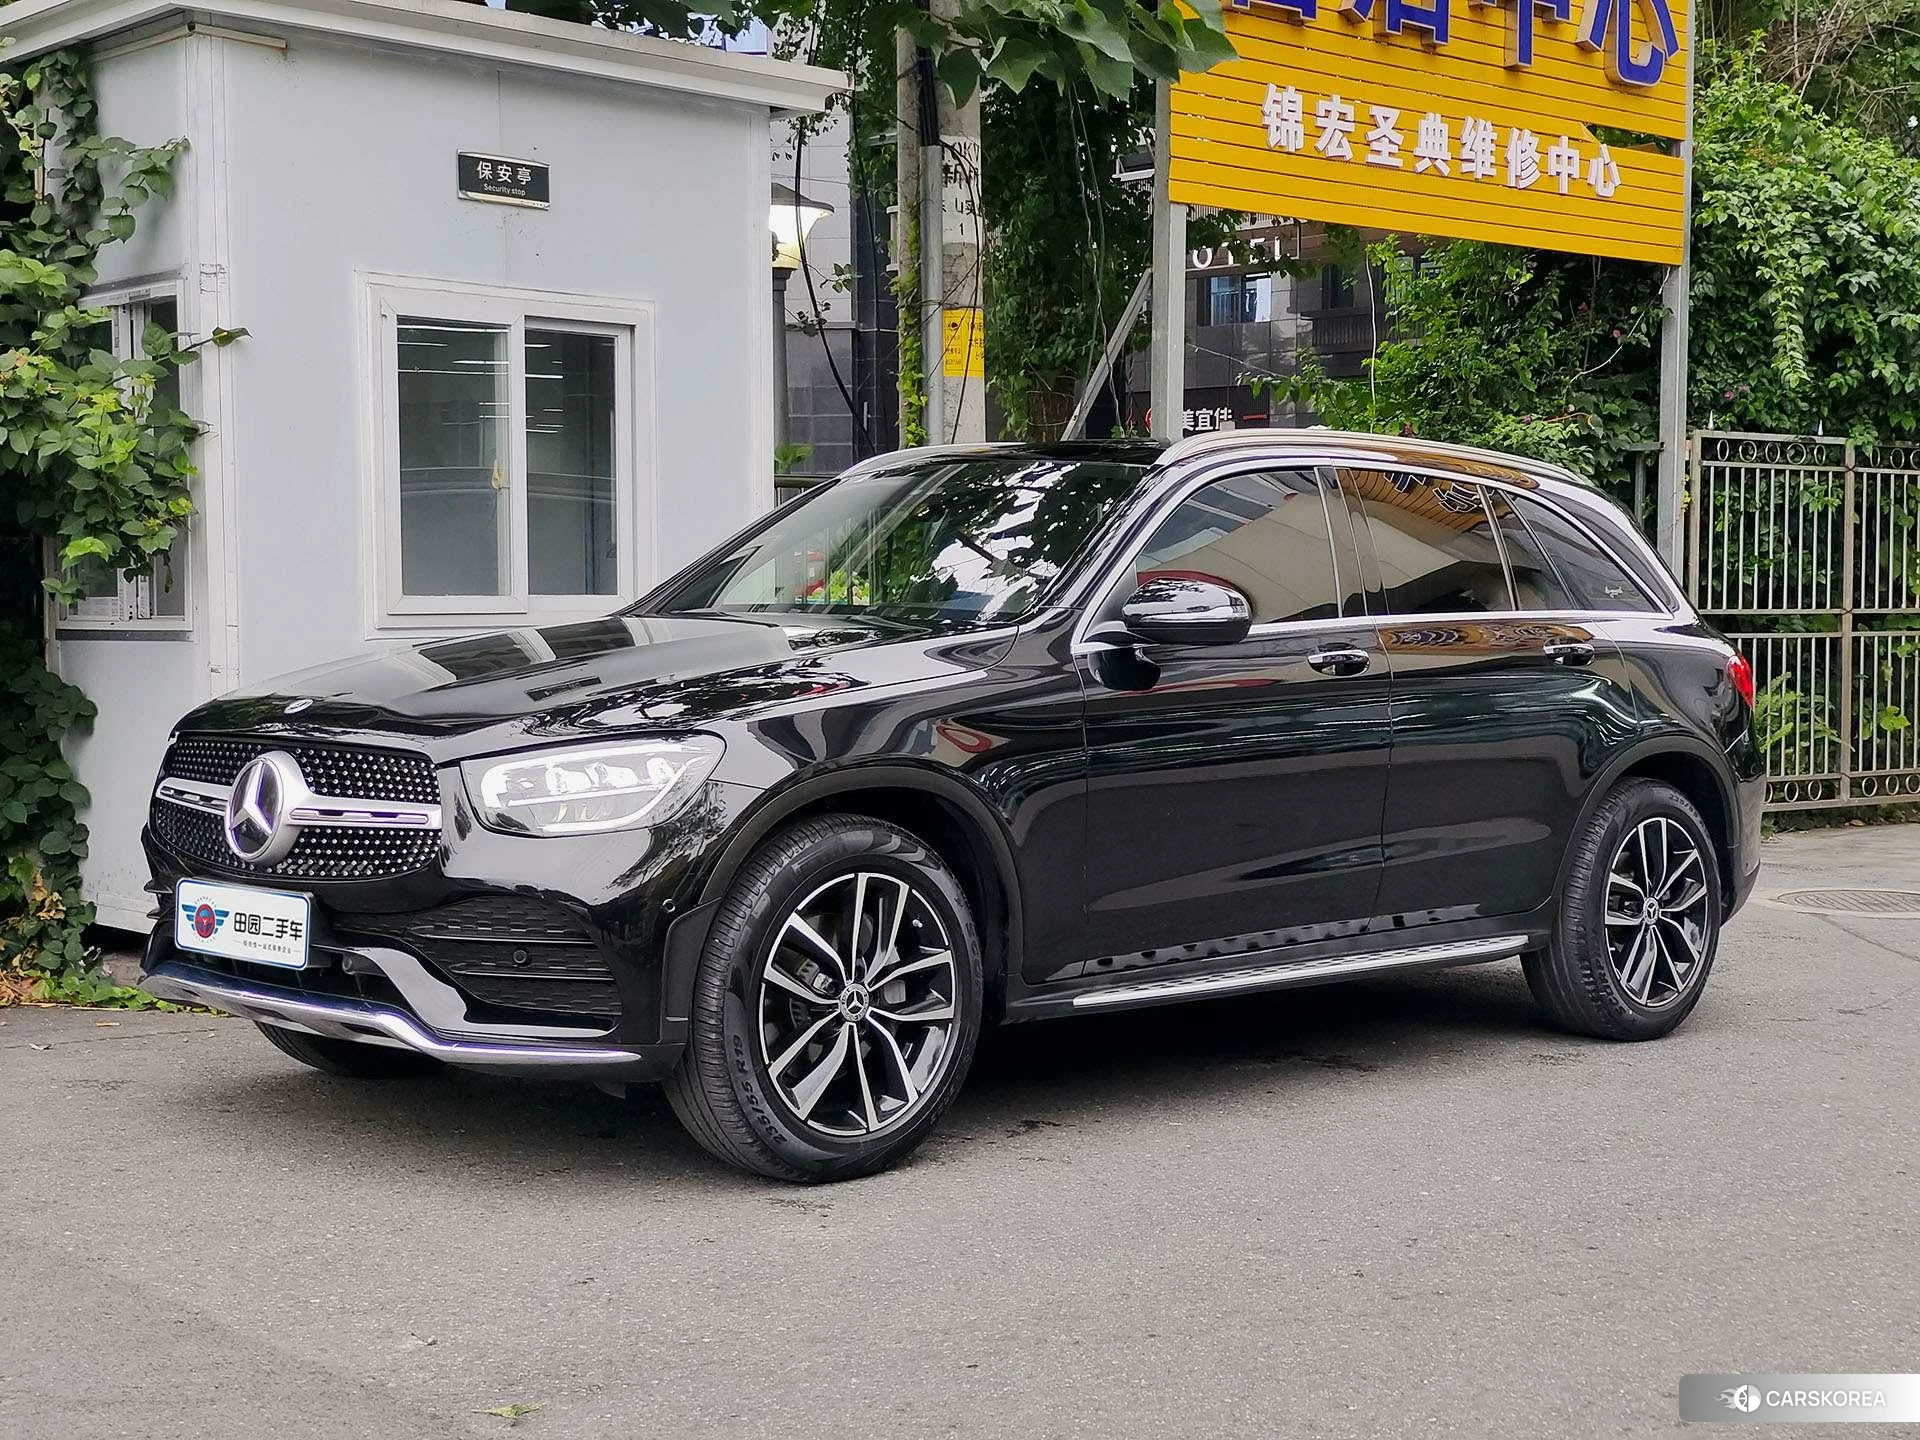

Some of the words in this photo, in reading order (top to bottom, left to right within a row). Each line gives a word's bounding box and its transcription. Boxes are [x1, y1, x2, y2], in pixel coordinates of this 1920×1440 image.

[1261, 83, 1621, 198] 锦宏圣典维修中心
[477, 160, 532, 186] 保安亭
[483, 183, 511, 195] Security
[511, 188, 526, 197] stop
[234, 912, 303, 941] 田园二手车
[742, 1082, 788, 1144] 235/55
